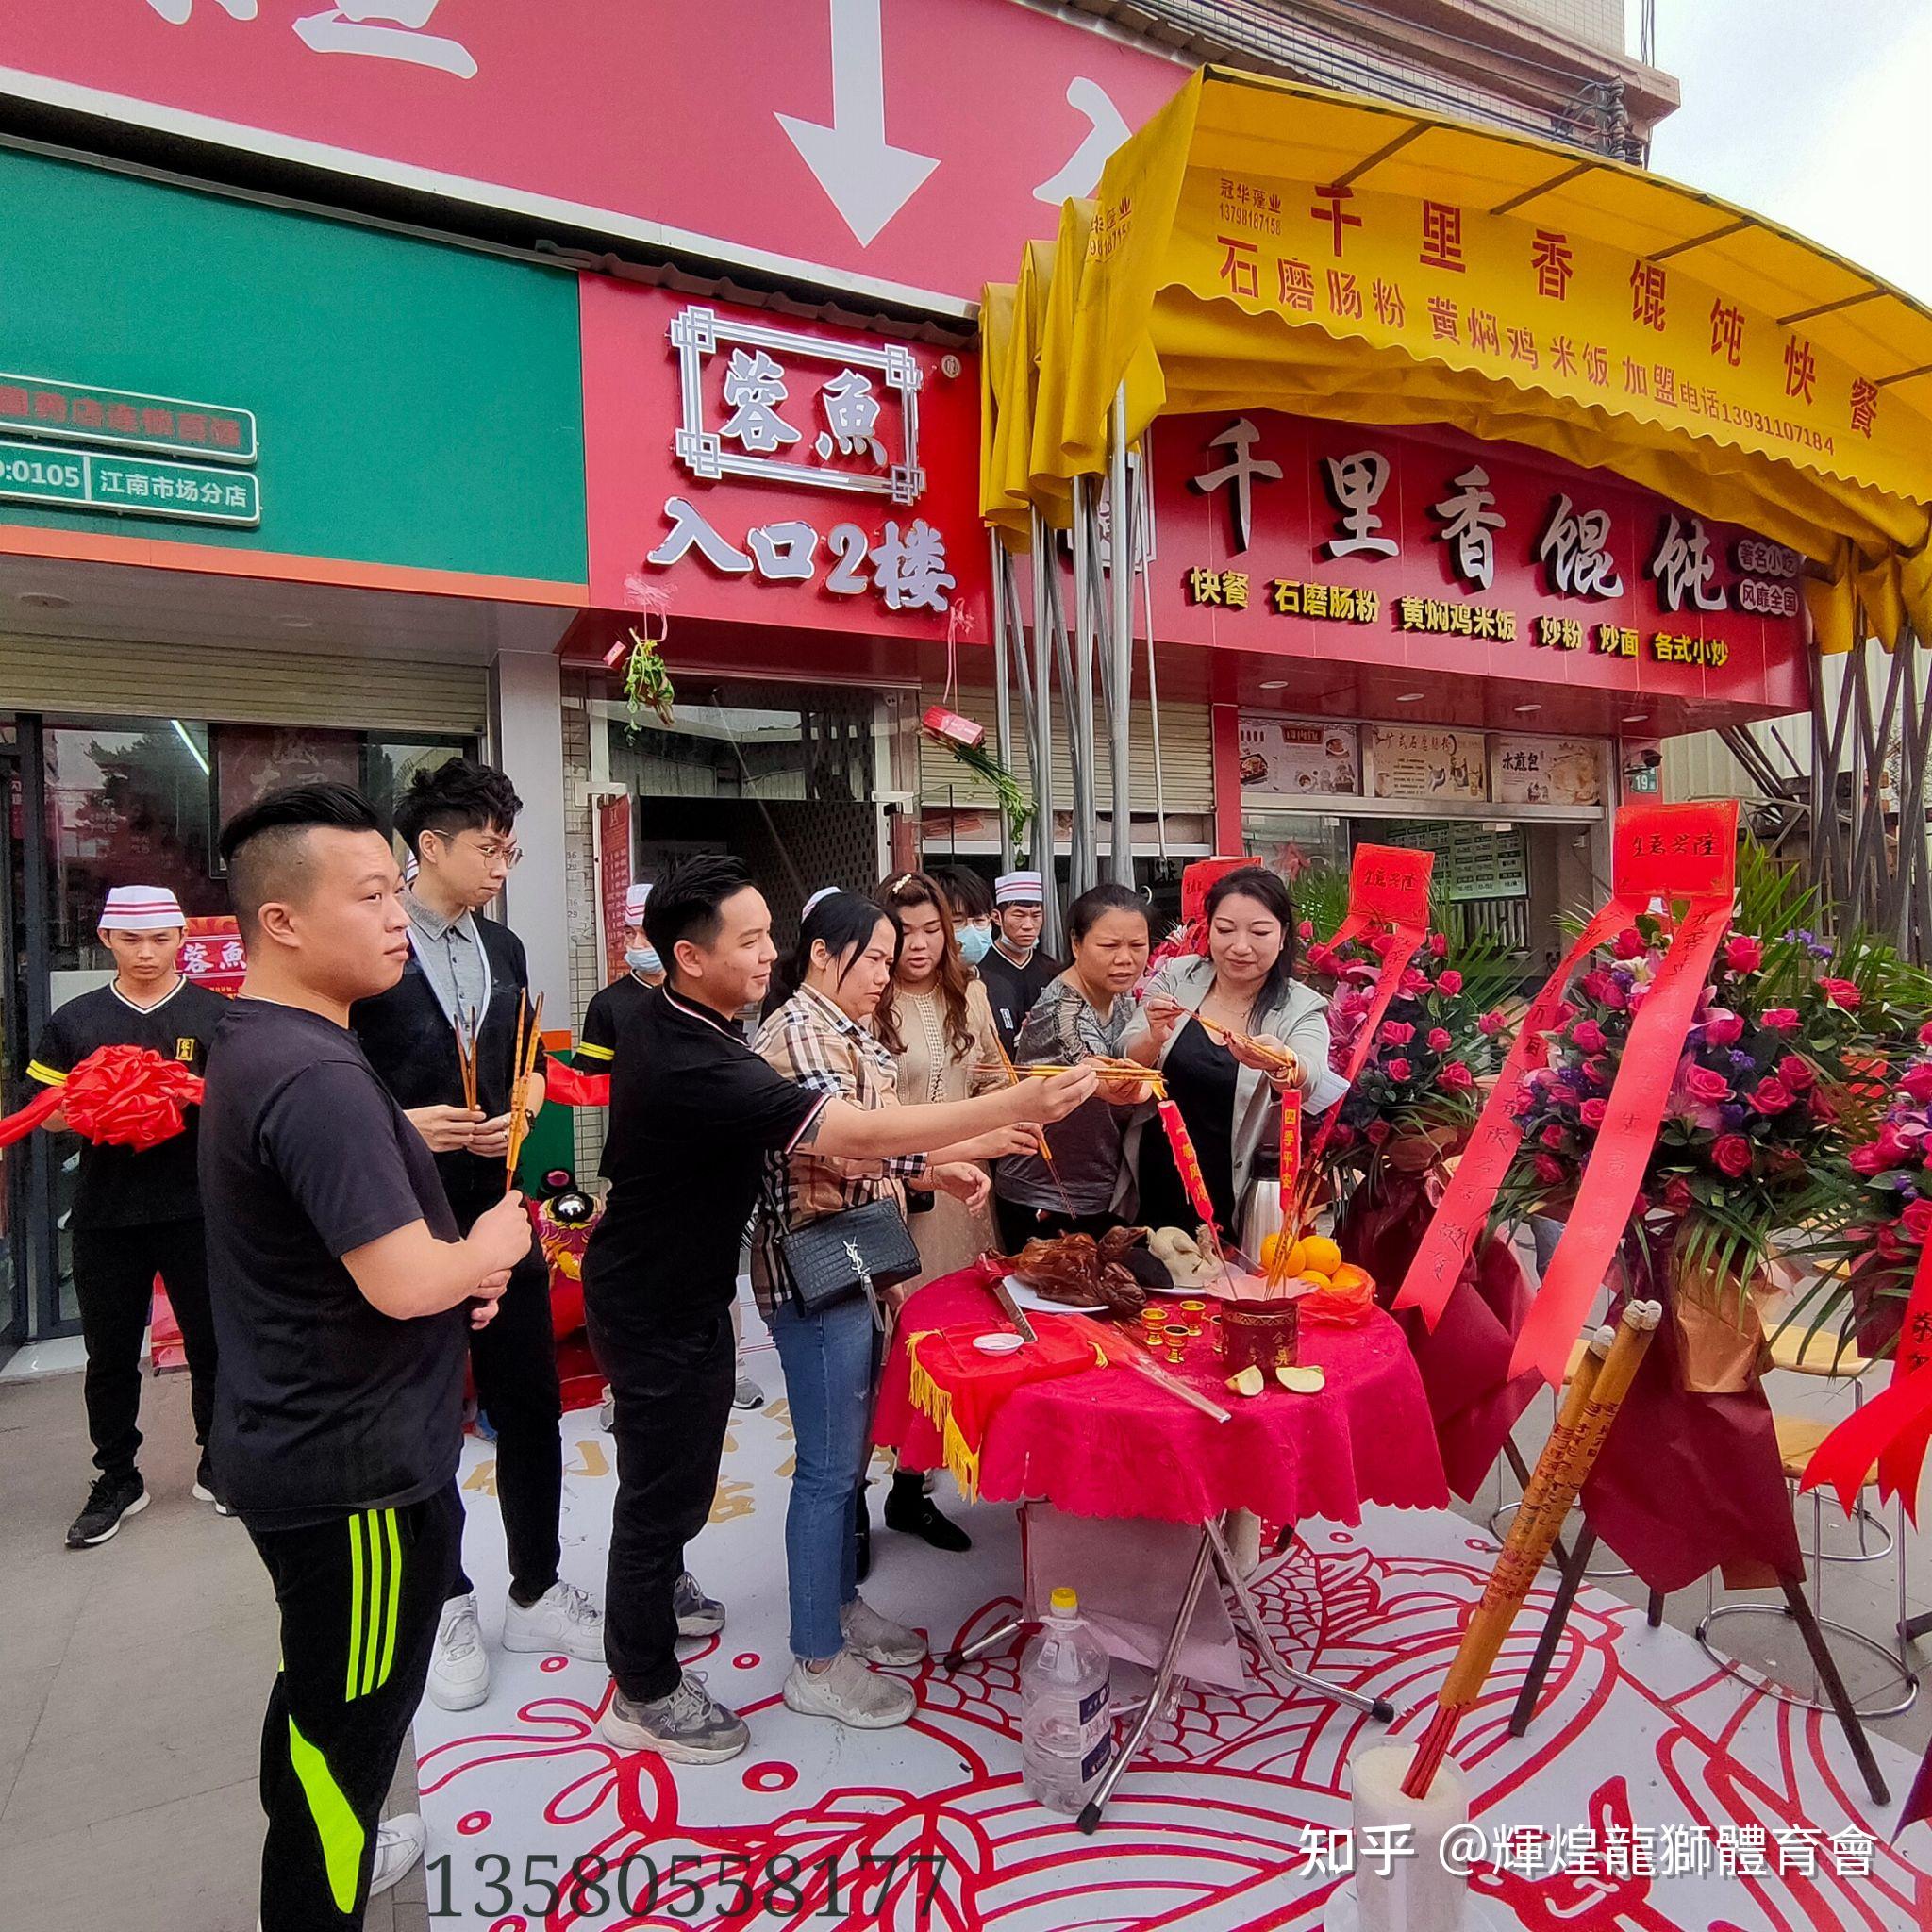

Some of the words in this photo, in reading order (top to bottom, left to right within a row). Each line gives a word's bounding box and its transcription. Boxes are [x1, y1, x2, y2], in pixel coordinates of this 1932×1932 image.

[1219, 202, 1282, 236] 13798187158
[1217, 234, 1407, 329] 石磨肠粉
[1428, 294, 1610, 389] 黄焖鸡米饭
[1311, 185, 1880, 440] 千里香馄饨快餐
[100, 469, 248, 508] 江南市场分店
[1194, 416, 1729, 612] 千里香馄饨
[647, 496, 957, 613] 入口2楼
[1741, 582, 1797, 614] 风靡全国
[1190, 565, 1249, 608] 快餐
[1274, 577, 1381, 624] 石磨肠粉
[1401, 595, 1518, 642] 黄焖鸡米饭
[1539, 614, 1583, 649] 炒粉
[1598, 622, 1640, 658] 炒面
[1654, 631, 1729, 668] 各式小炒
